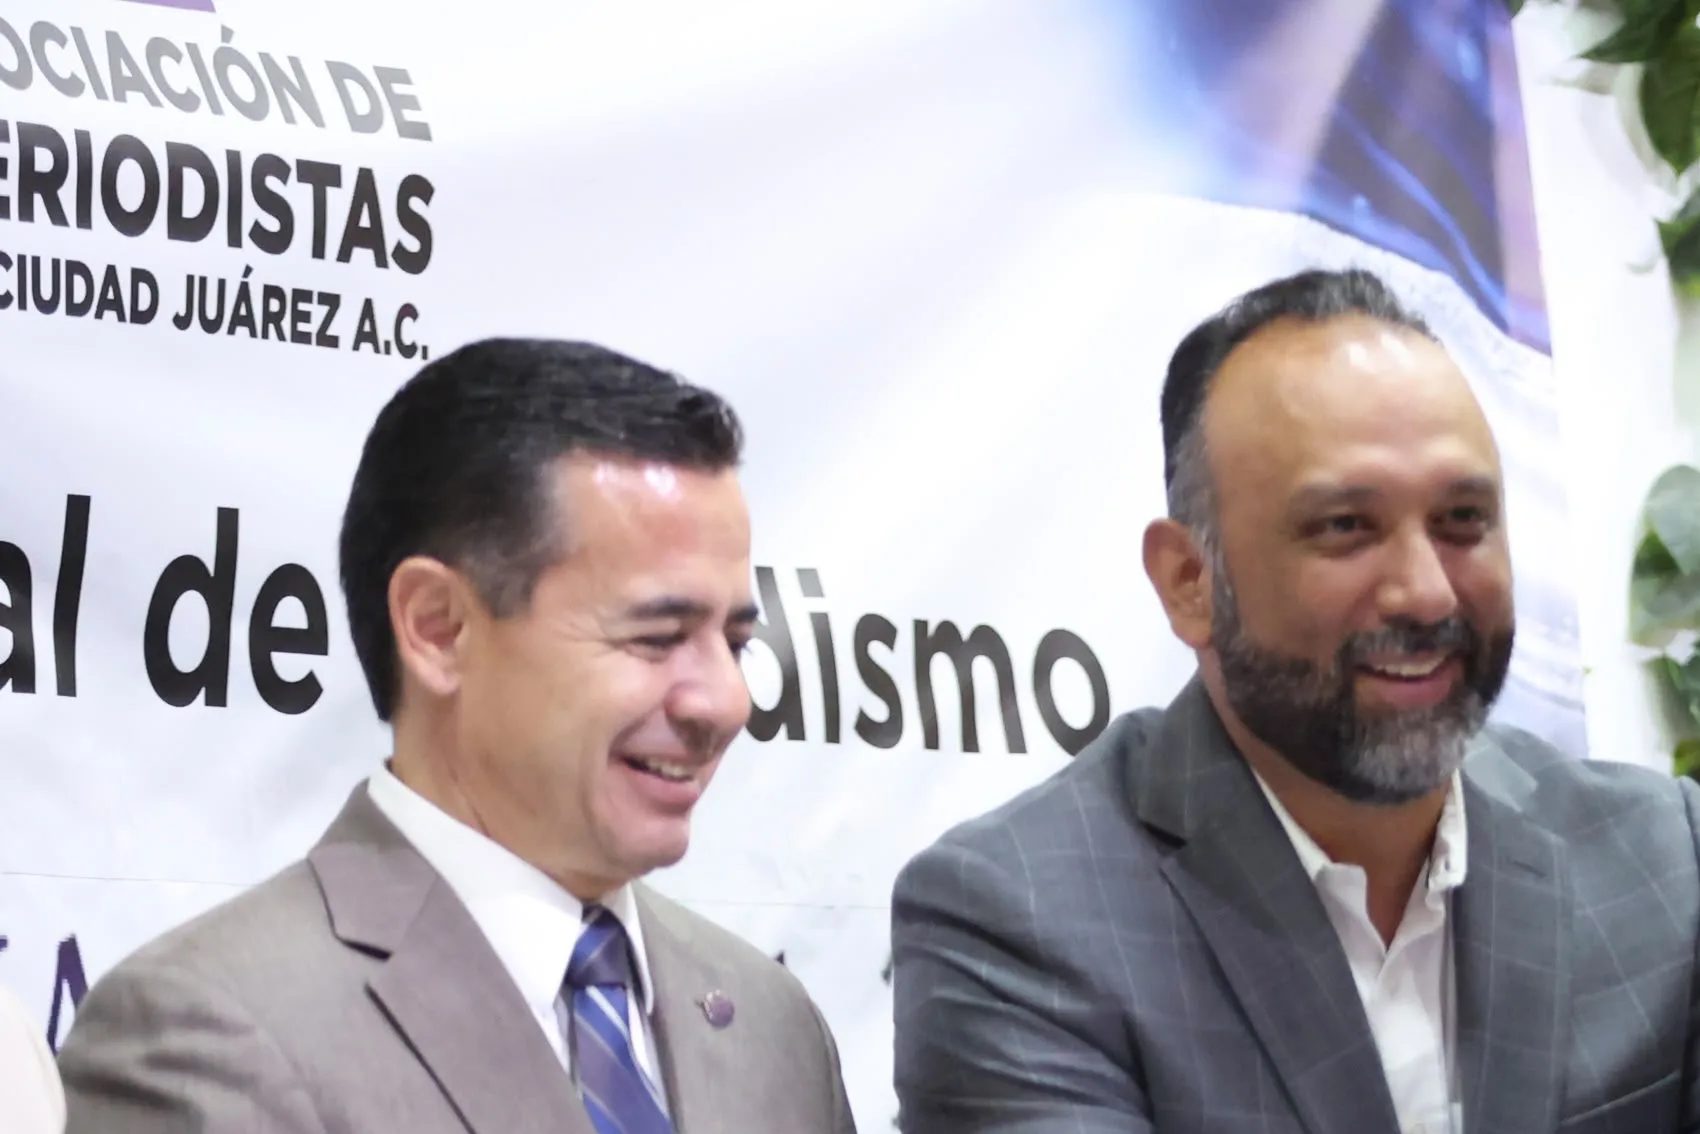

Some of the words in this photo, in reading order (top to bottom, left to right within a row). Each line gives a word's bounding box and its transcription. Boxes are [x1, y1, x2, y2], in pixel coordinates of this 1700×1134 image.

[325, 60, 432, 141] DE
[0, 119, 435, 275] RIODISTAS
[172, 265, 340, 349] JUÁREZ
[352, 297, 429, 360] A.C.
[144, 507, 329, 715] de
